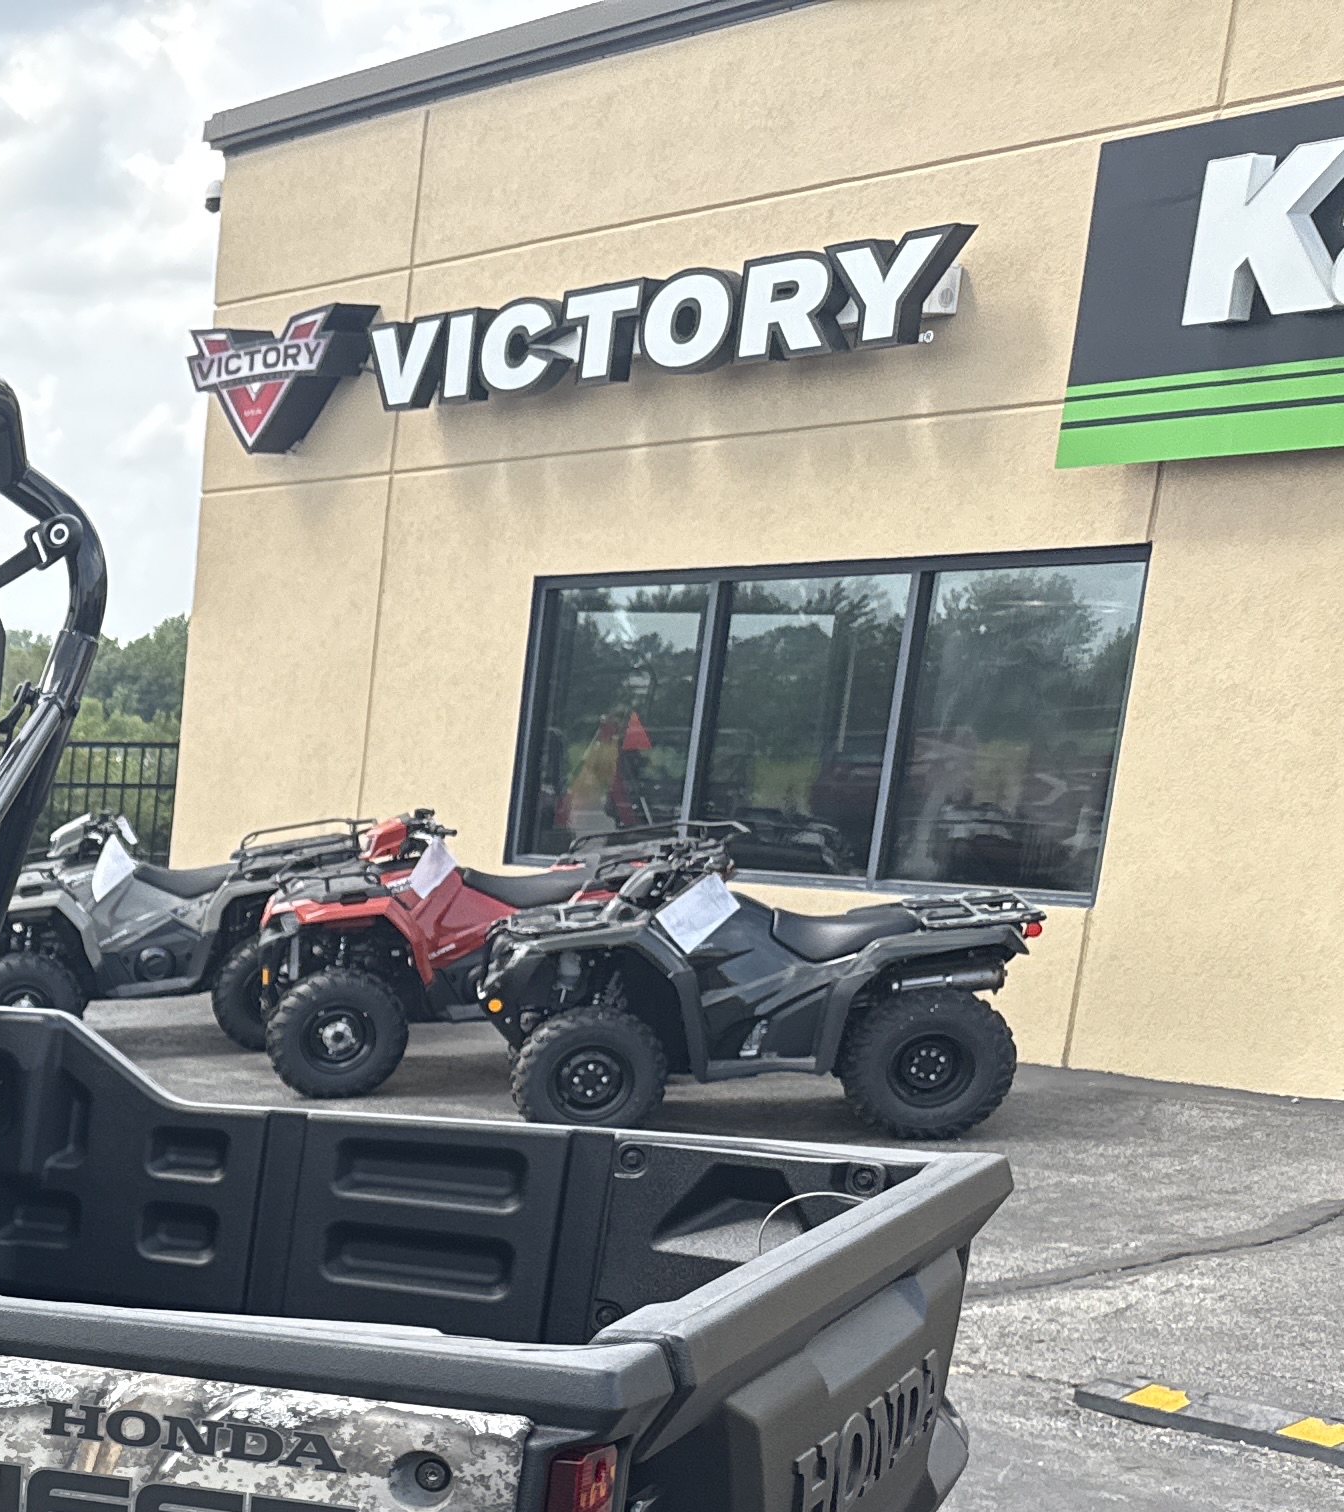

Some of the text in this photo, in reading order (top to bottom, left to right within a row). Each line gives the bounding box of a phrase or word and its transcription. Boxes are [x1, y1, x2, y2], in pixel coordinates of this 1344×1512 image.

[1180, 136, 1344, 326] K
[196, 340, 322, 381] VICTORY
[368, 228, 954, 412] VICTORY
[43, 1401, 346, 1473] HONDA
